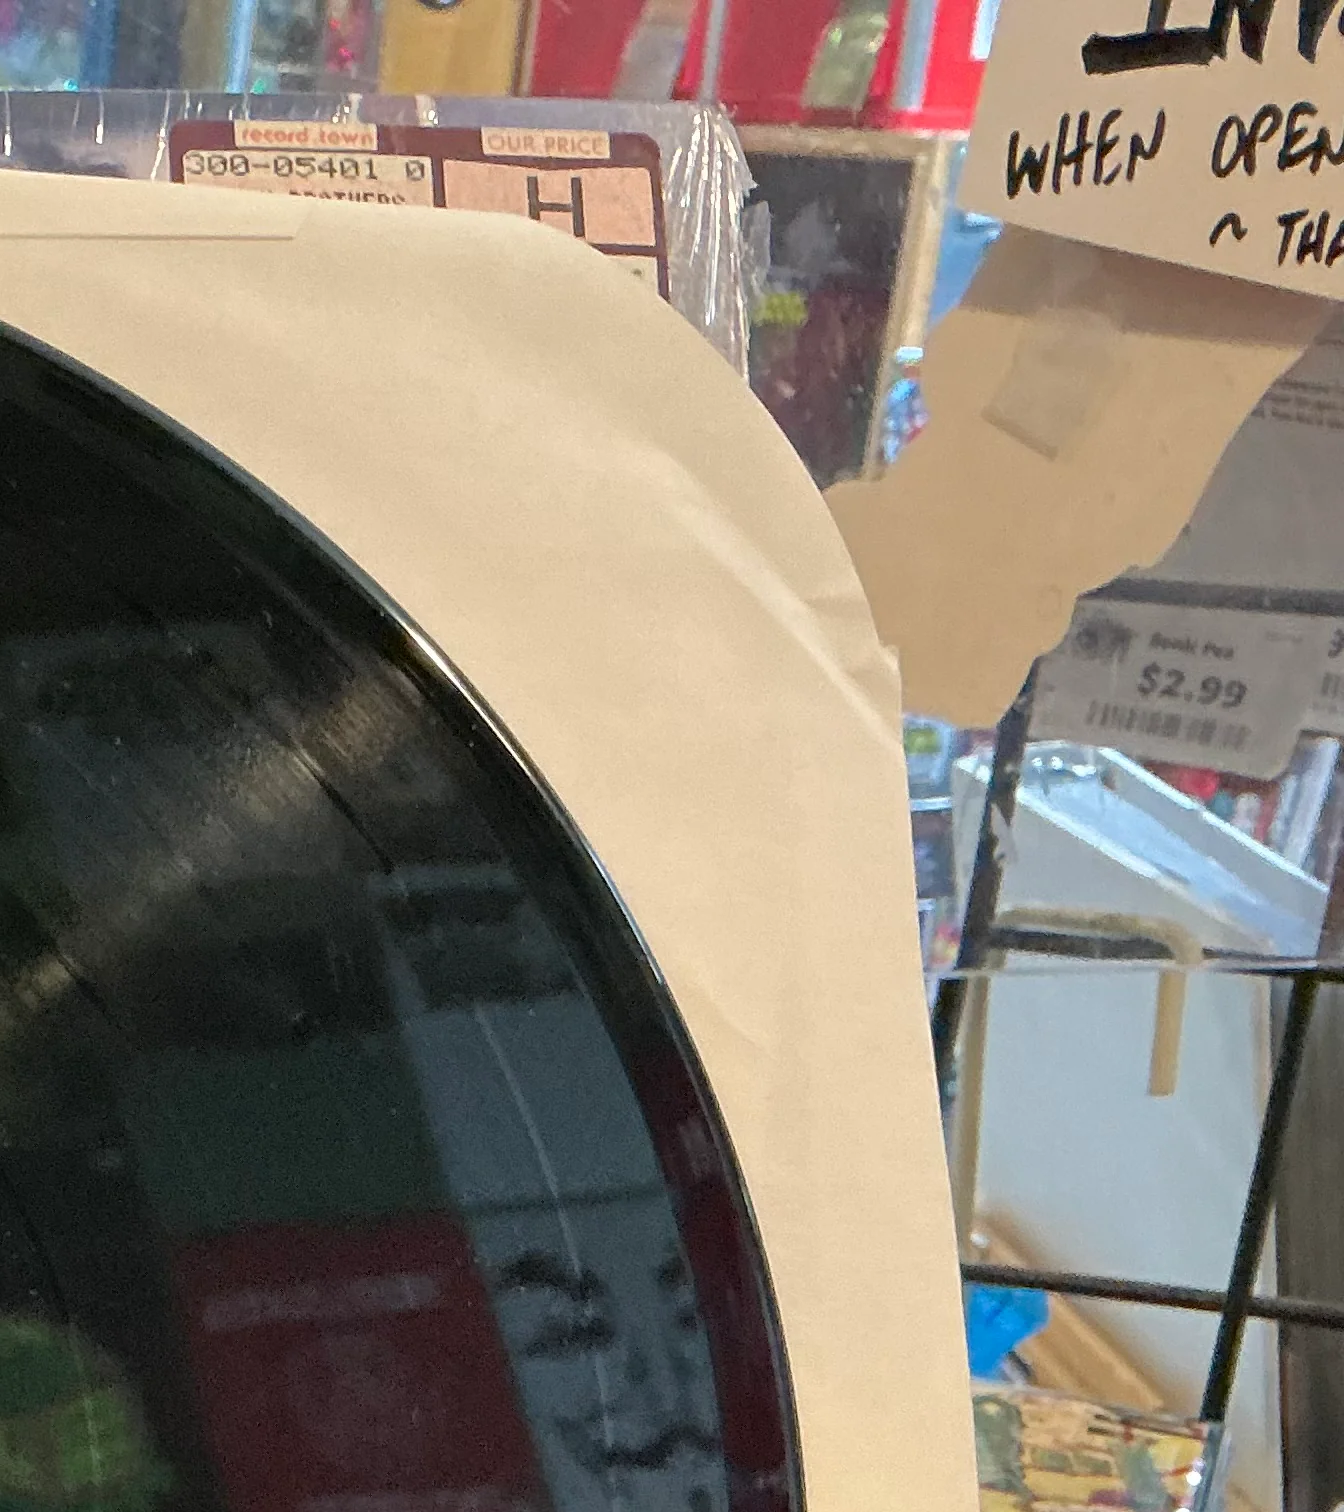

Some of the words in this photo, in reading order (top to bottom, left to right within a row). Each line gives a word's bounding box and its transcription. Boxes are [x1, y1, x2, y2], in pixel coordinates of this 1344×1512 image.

[242, 126, 309, 147] record
[318, 127, 375, 147] town
[486, 132, 535, 154] OUR
[542, 134, 607, 156] PRICE
[185, 150, 378, 182] 300-05401
[1007, 108, 1166, 199] WHEN
[1137, 660, 1249, 709] $2.99
